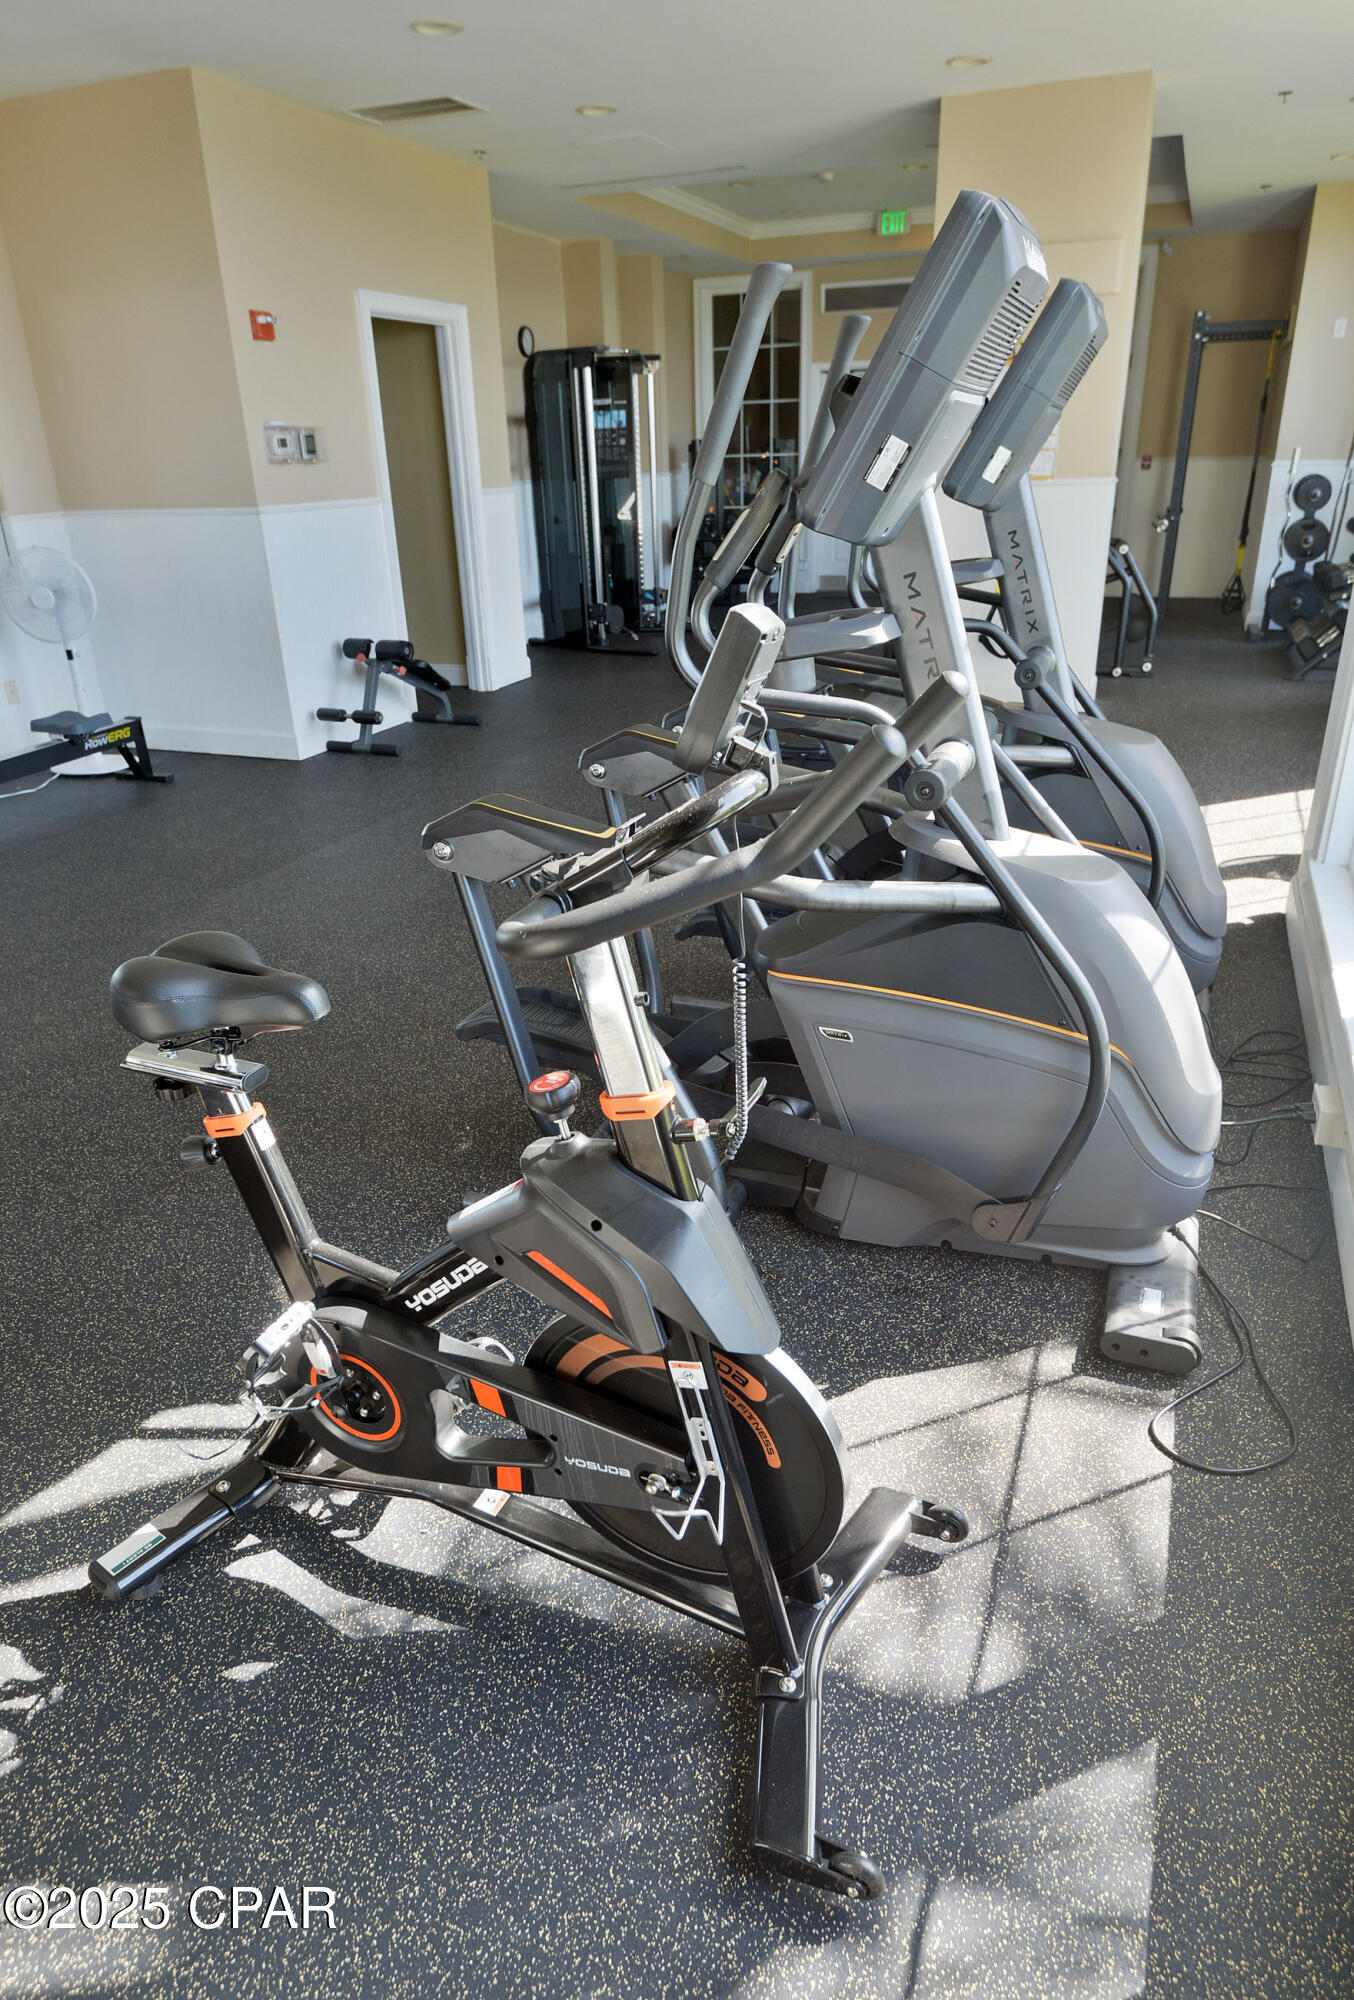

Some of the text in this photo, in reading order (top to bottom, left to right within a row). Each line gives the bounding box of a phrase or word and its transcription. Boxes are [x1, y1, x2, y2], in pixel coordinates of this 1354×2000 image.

[881, 211, 906, 235] EXIT
[1007, 529, 1039, 634] MATRIX
[903, 571, 941, 680] MATR
[404, 1256, 489, 1312] YOSUDA
[564, 1455, 632, 1478] YOSUDA
